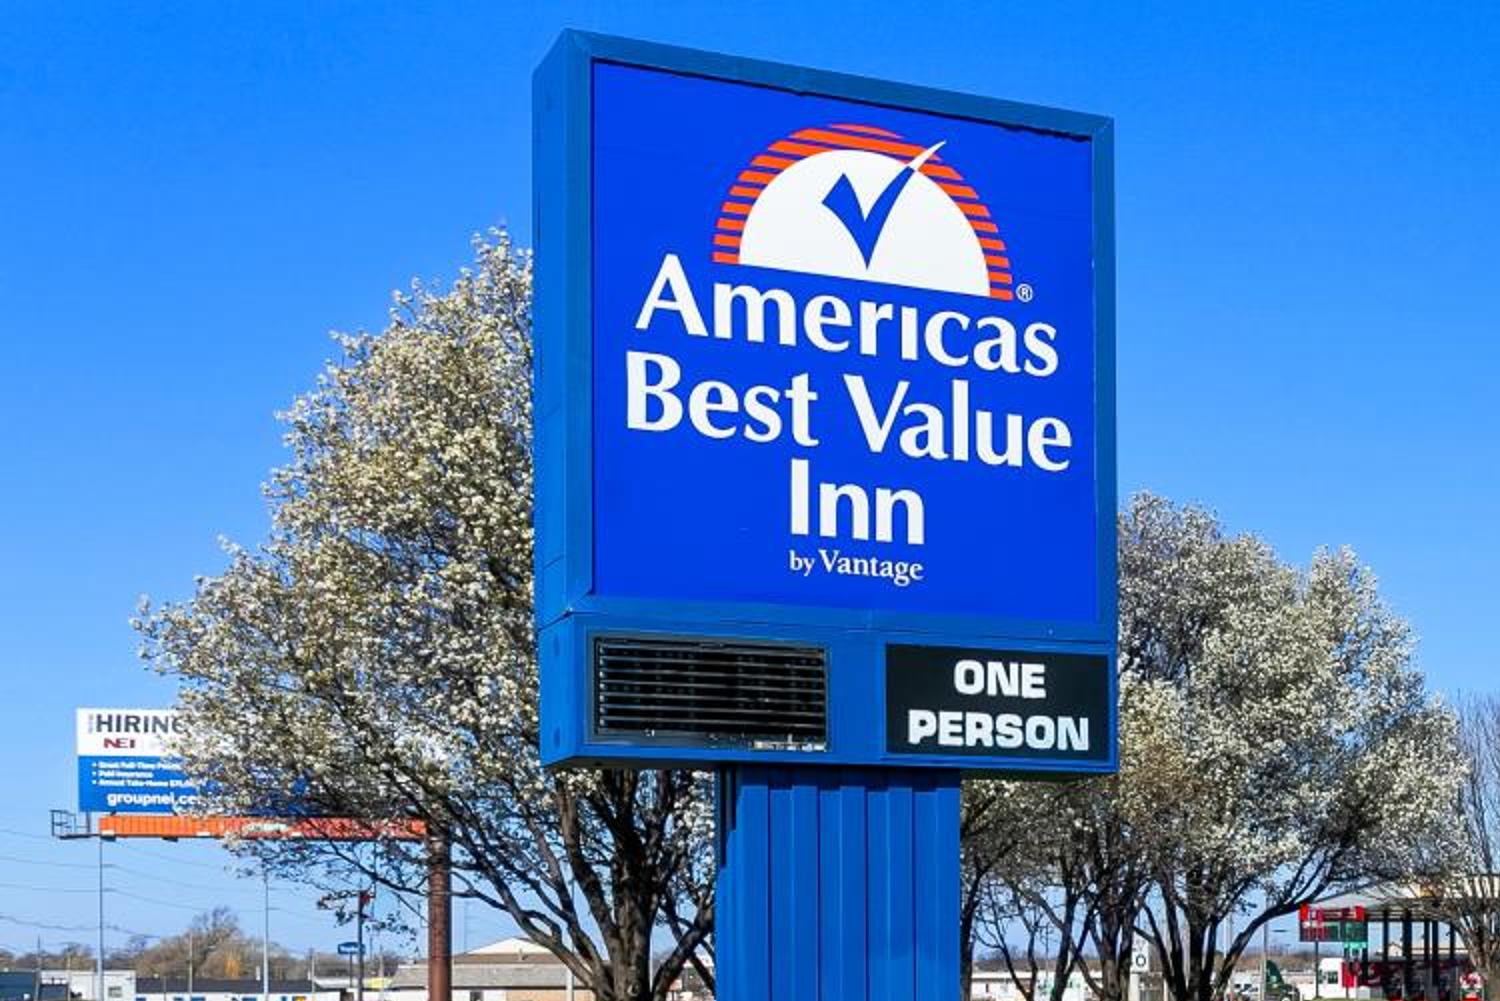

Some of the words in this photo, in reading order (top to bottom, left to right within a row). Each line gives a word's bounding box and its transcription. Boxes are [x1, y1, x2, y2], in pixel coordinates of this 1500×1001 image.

[635, 253, 1059, 377] Americas
[626, 351, 819, 447] Best
[843, 373, 1072, 471] Value
[791, 458, 925, 545] Inn
[790, 550, 814, 577] by
[818, 549, 924, 586] Vantage
[953, 659, 1047, 699] ONE
[103, 737, 136, 749] NEI
[907, 709, 1090, 752] PERSON
